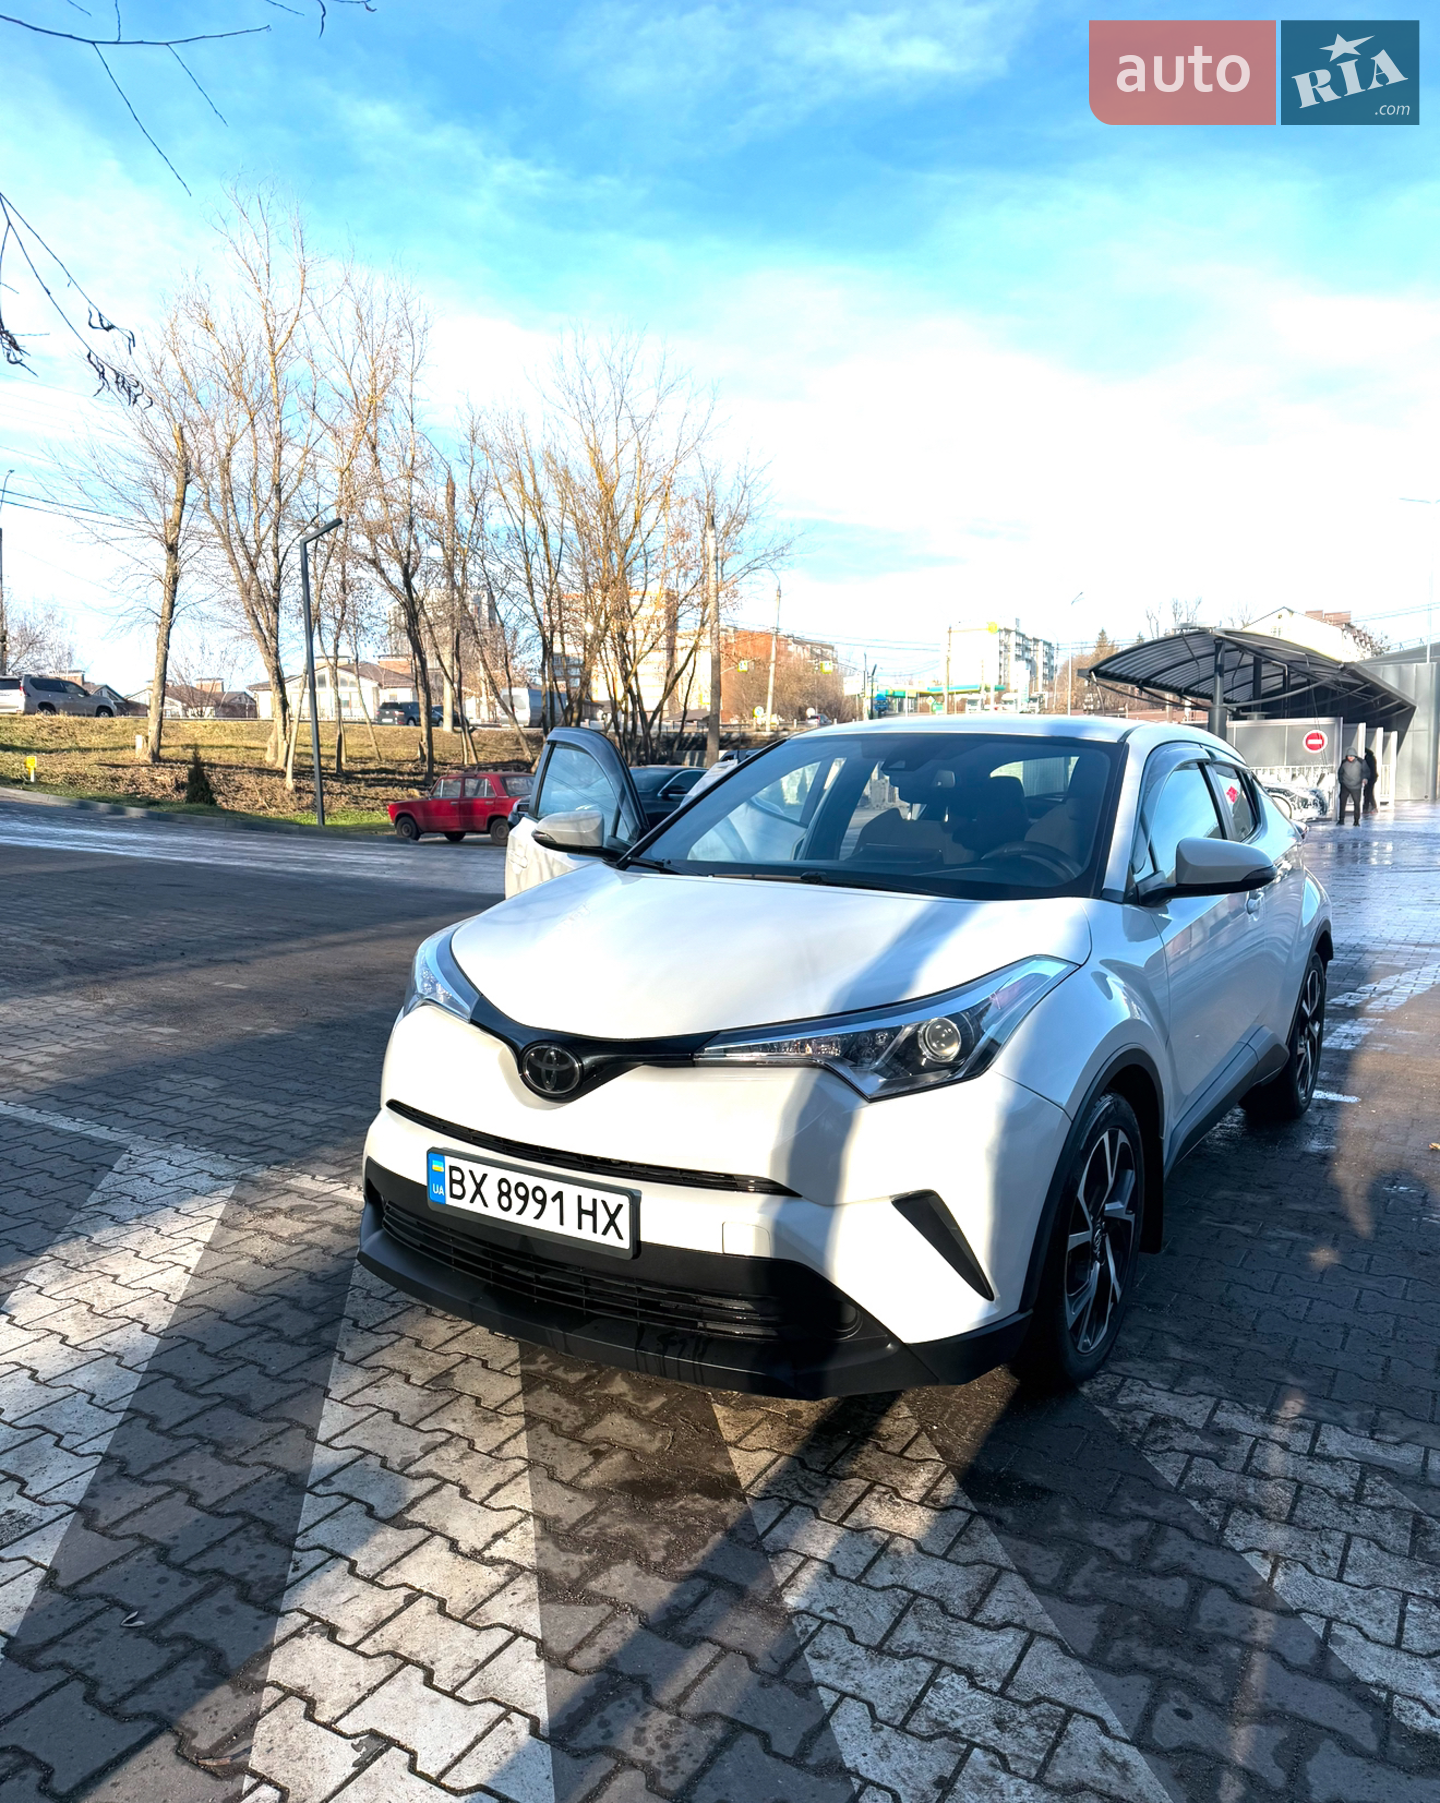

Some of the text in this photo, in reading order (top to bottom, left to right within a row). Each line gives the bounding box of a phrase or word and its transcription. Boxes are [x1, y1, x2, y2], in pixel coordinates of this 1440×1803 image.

[432, 1183, 445, 1196] UA
[448, 1165, 624, 1241] BX 8991 HX
